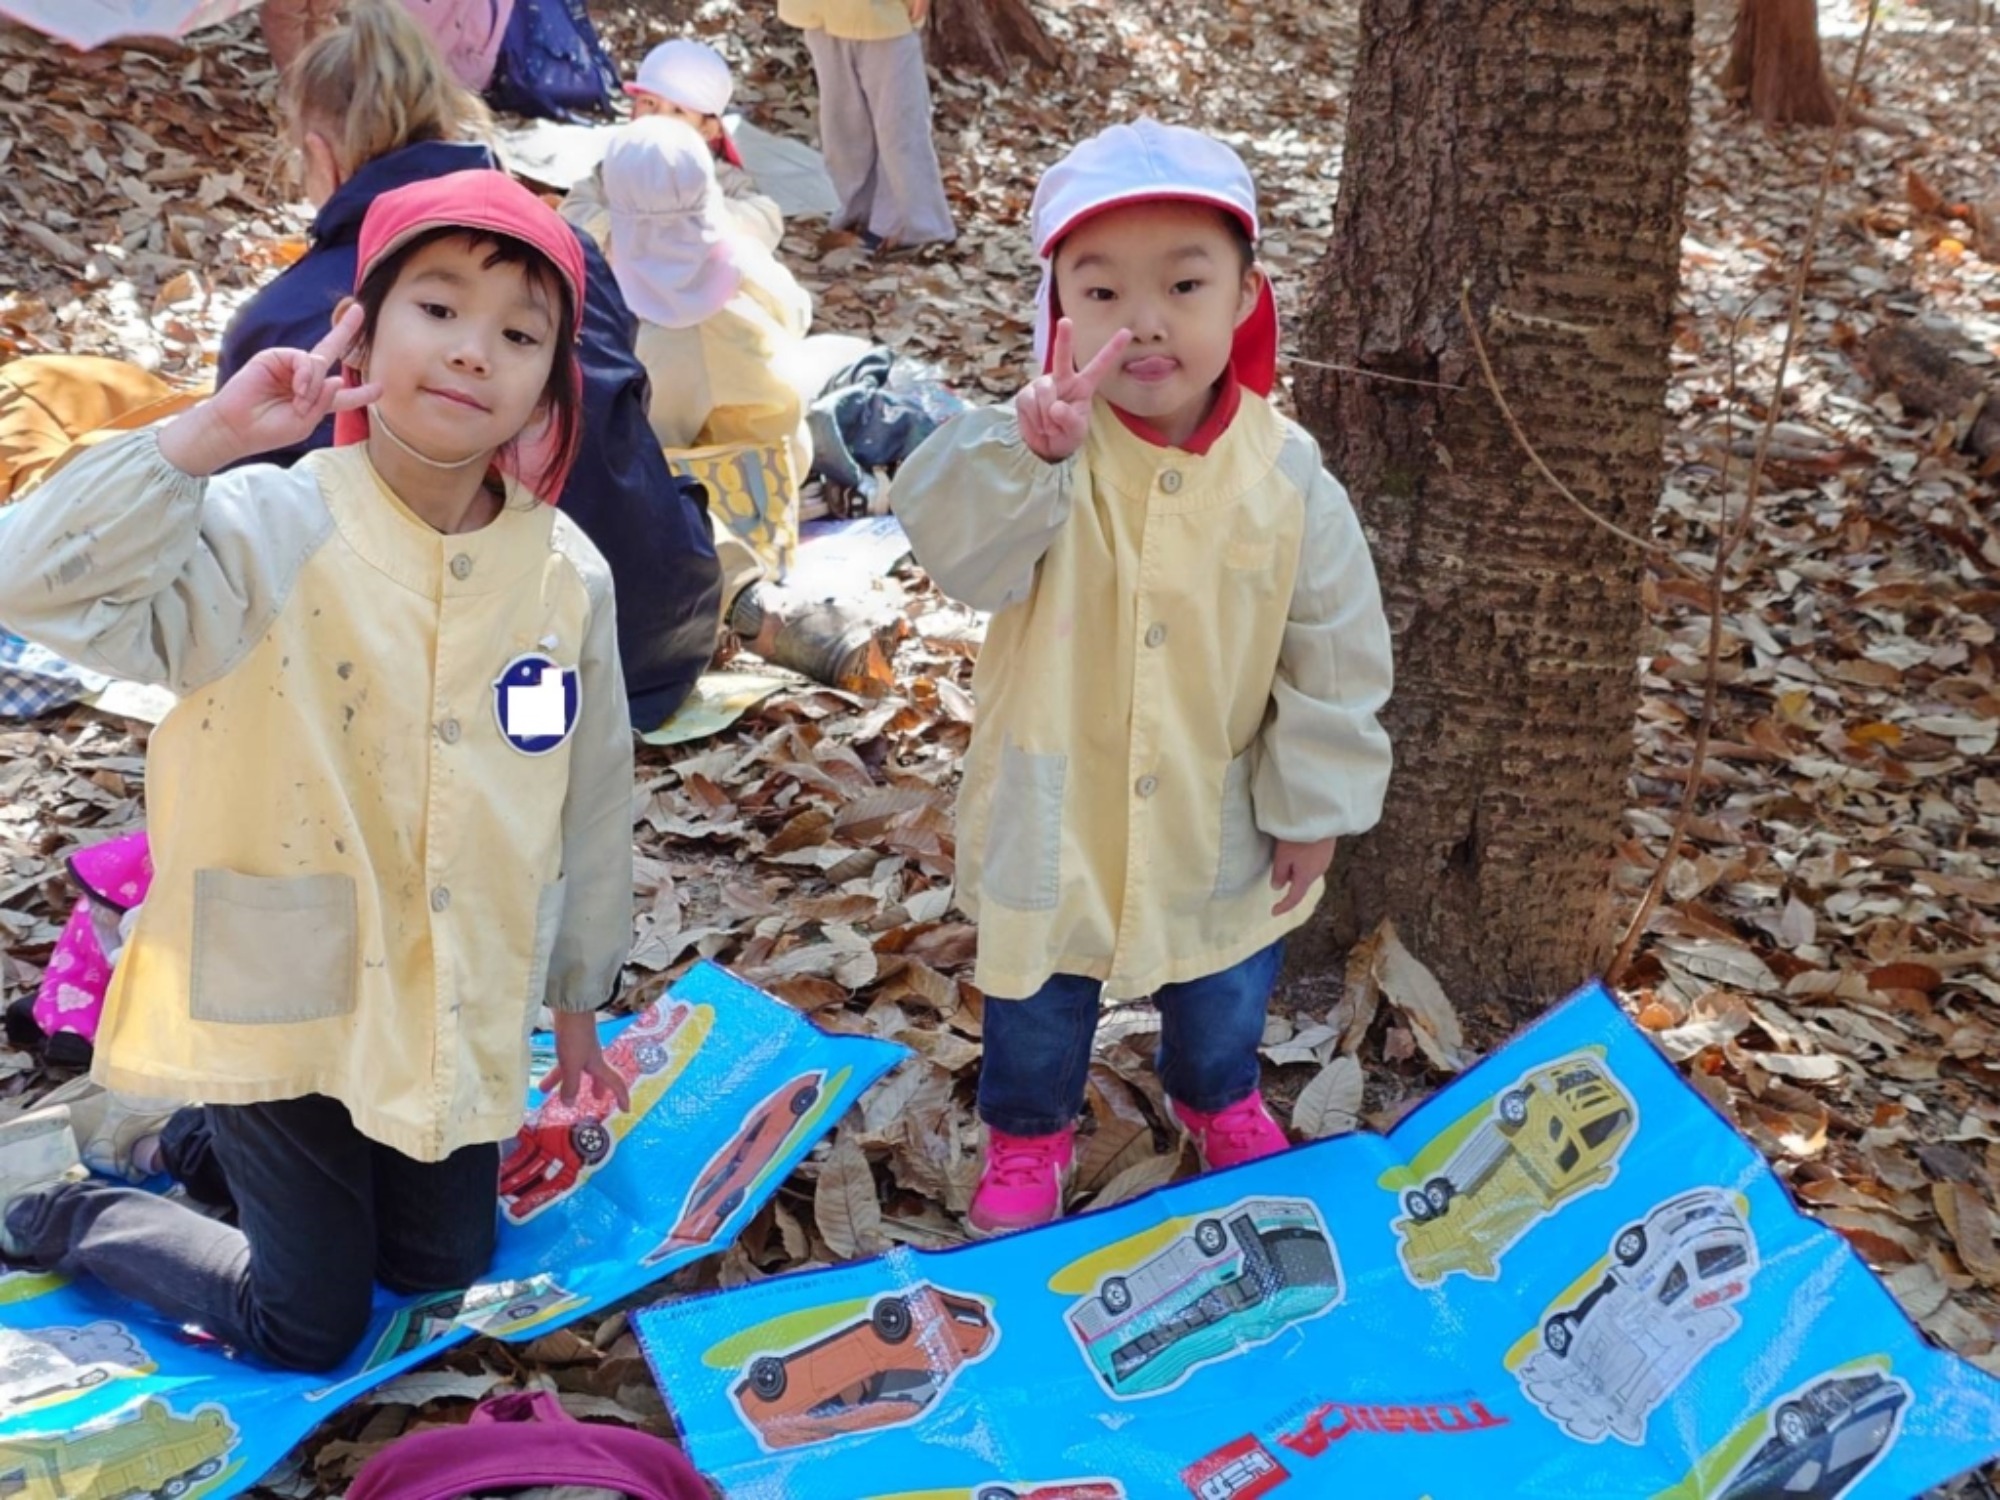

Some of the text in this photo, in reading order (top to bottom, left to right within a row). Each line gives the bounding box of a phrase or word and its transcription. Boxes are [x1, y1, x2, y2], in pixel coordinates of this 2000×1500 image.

[1277, 1400, 1511, 1457] TOMICA
[1198, 1450, 1276, 1500] トミカ
